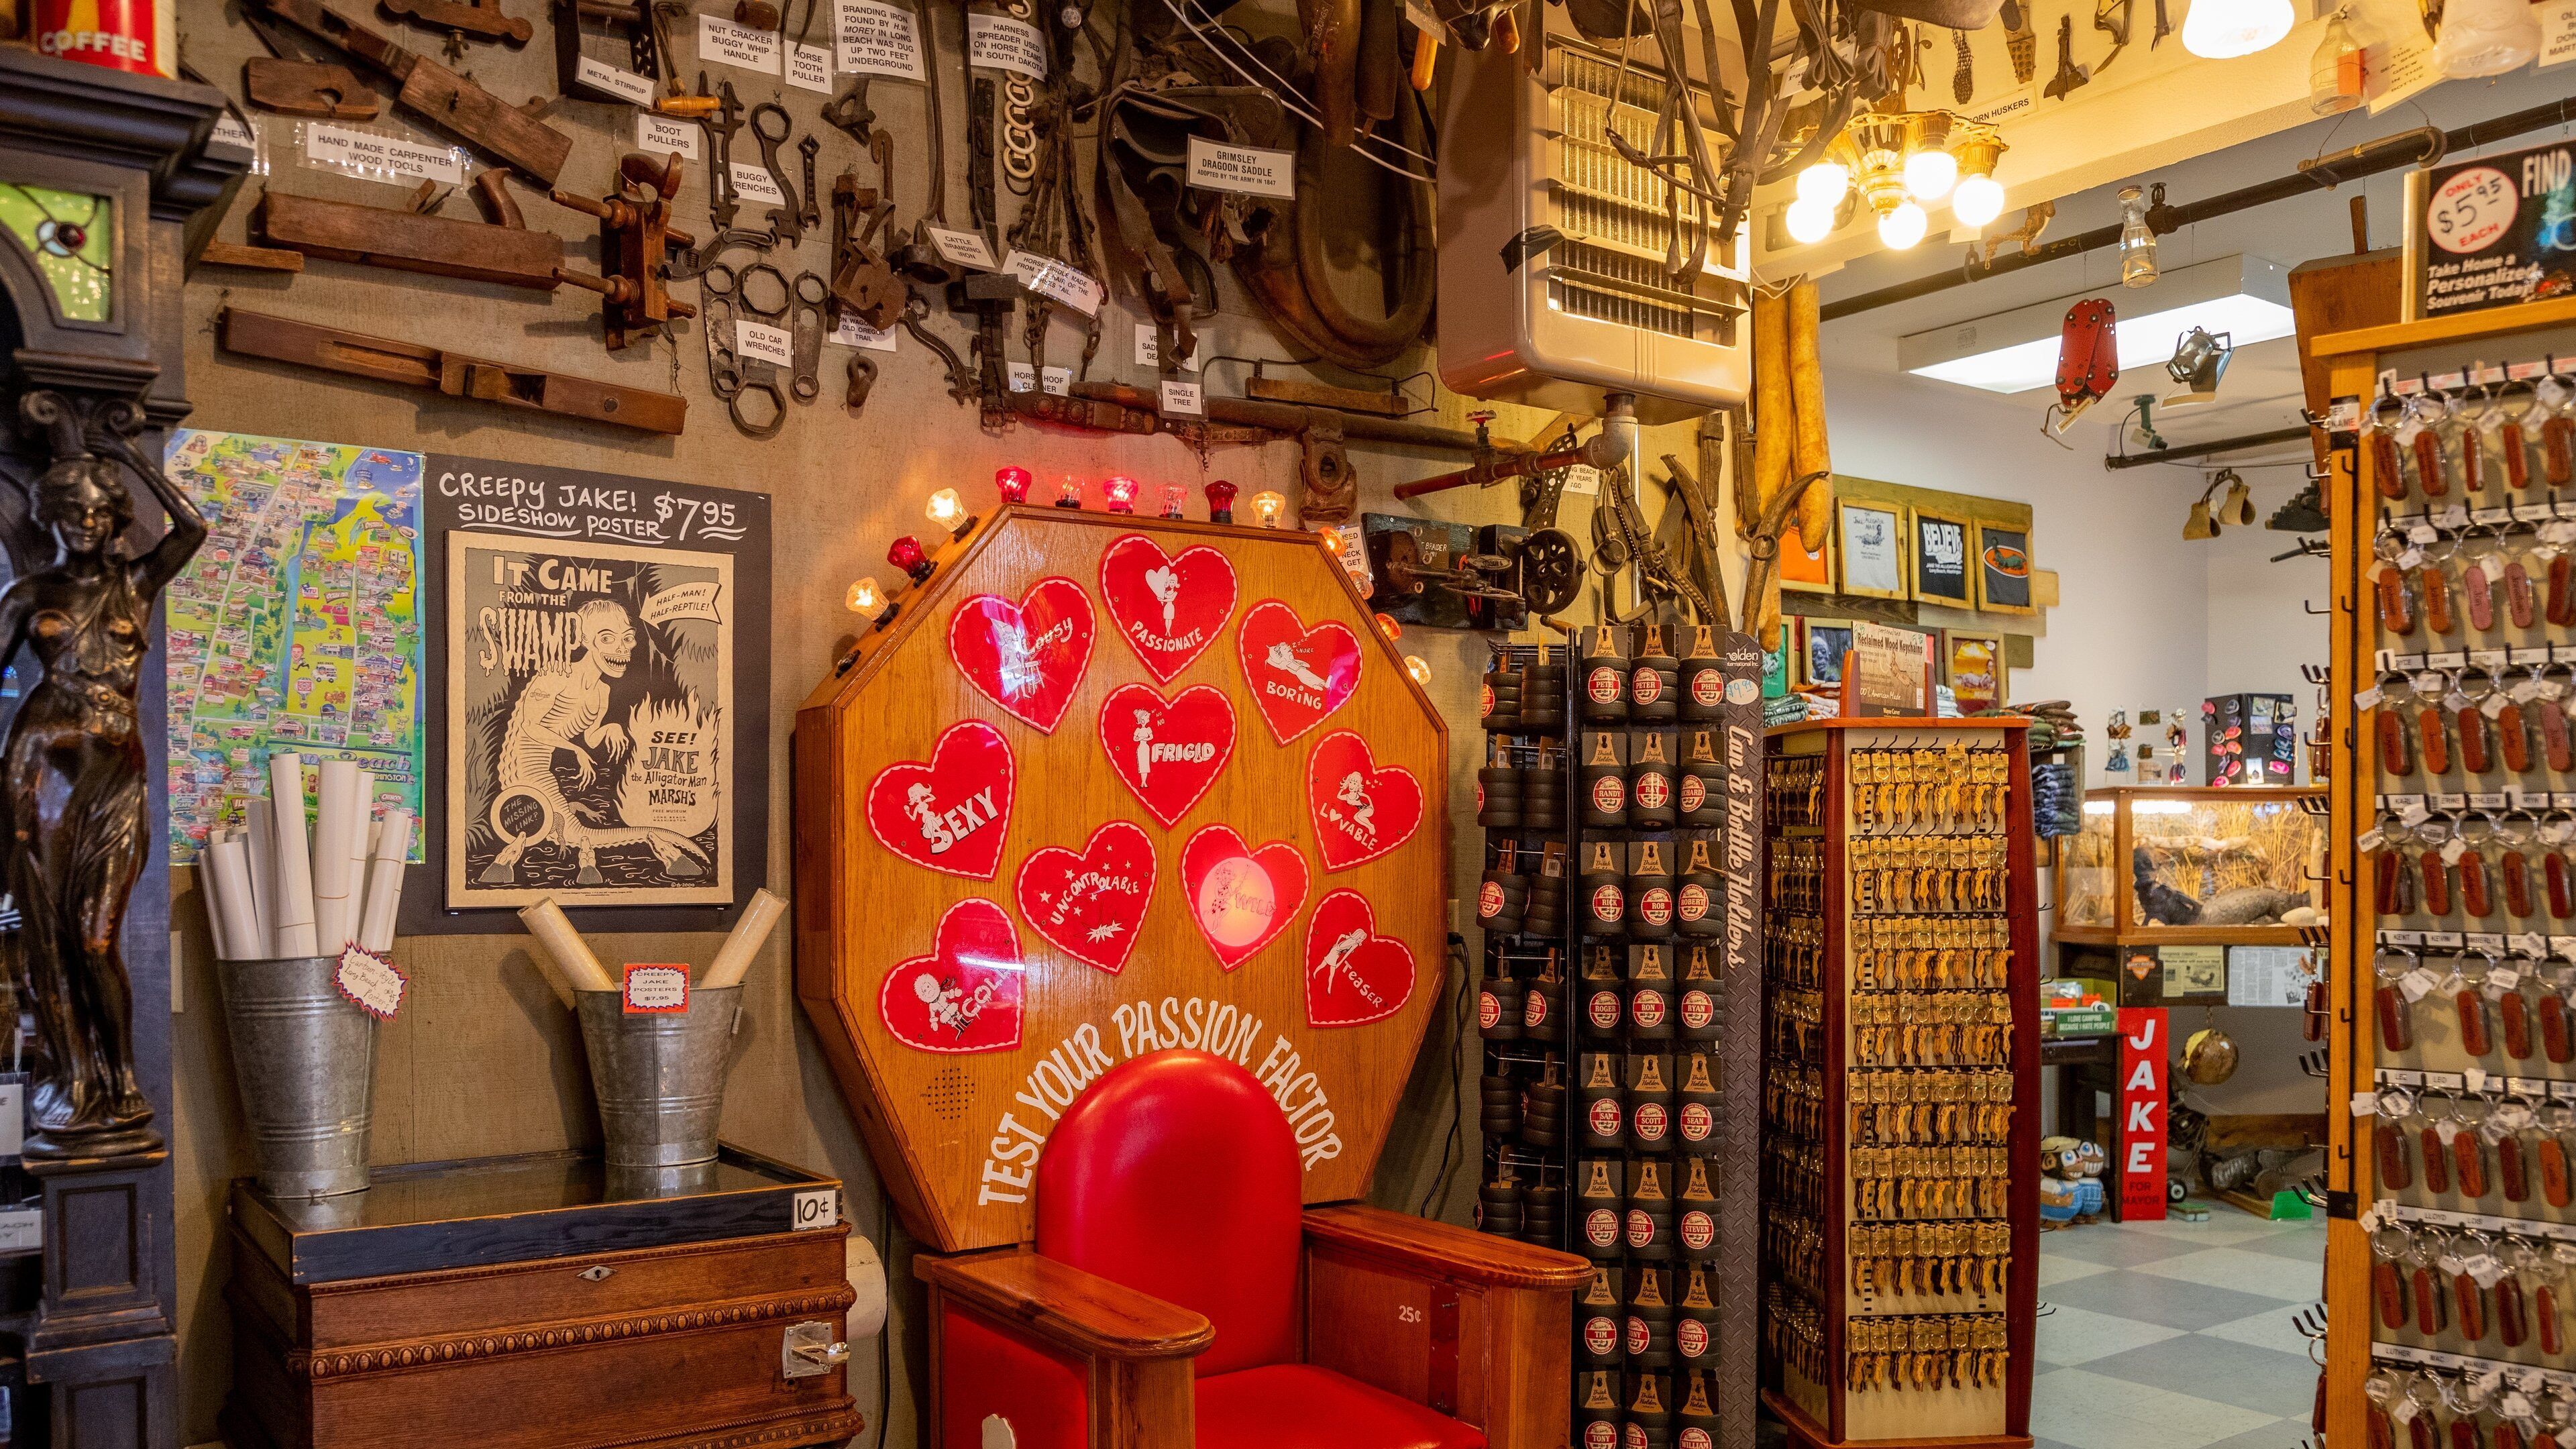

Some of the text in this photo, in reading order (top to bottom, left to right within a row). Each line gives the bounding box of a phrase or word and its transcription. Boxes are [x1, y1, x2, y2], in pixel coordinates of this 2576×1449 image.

[843, 5, 908, 23] BRANDING IRON
[845, 15, 875, 26] FOUND
[708, 24, 772, 45] NUT CRACKER
[844, 26, 911, 42] MOREY LONG
[994, 23, 1029, 38] HARNESS
[40, 29, 146, 62] COFFEE
[712, 36, 769, 55] BUGGY WHIP
[843, 36, 914, 52] BEACH WAS DUG
[977, 32, 1040, 52] SPREADER USED
[724, 49, 759, 62] HANDLE
[794, 50, 822, 63] HORSE
[867, 48, 885, 57] TWO
[890, 52, 910, 60] FEET
[991, 43, 1018, 53] HORSE
[1022, 48, 1042, 62] TEAMS
[2400, 48, 2426, 63] SHELL
[794, 60, 822, 72] TOOTH
[848, 56, 913, 71] UNDERGROUND
[986, 52, 1014, 62] SOUTH
[1018, 58, 1043, 73] DAKOTA
[2393, 61, 2417, 74] GREW
[587, 68, 646, 95] METAL STIRRUP
[792, 70, 825, 84] PULLER
[2391, 74, 2424, 92] BOTTLE
[1992, 99, 2029, 117] HUSKERS
[655, 124, 682, 136] BOOT
[647, 134, 689, 148] PULLERS
[318, 135, 452, 167] HAND MADE CARPENTER
[1217, 151, 1257, 164] GRIMSLEY
[349, 152, 423, 173] WOOD TOOLS
[1202, 158, 1272, 177] DRAGOON SADDLE
[737, 172, 767, 182] BUGGY
[1197, 169, 1219, 178] ADOPTED
[2522, 150, 2572, 198] FIND
[2445, 175, 2482, 197] ONLY
[945, 236, 972, 246] CATTLE
[2459, 223, 2500, 247] EACH
[944, 243, 981, 254] BRANDING
[958, 251, 976, 260] IRON
[1024, 258, 1069, 278] HORSE BRIDLE
[2428, 256, 2504, 278] Take Home
[1017, 262, 1089, 296] FROM THE
[2427, 262, 2541, 295] Personalized
[2427, 291, 2486, 309] Souvenir
[749, 331, 782, 345] OLD CAR
[859, 327, 885, 335] OREGON
[745, 340, 786, 357] WRENCHES
[1044, 376, 1063, 384] HOOF
[1169, 389, 1194, 397] SINGLE
[559, 485, 637, 513] JAKE!
[459, 503, 661, 537] SIDESHOW POSTER
[493, 555, 612, 594] IT CAME
[499, 590, 566, 607] FROM THE
[656, 588, 706, 606] HALF-MAN!
[649, 603, 710, 621] HALF-REPTILE!
[478, 607, 584, 678] SWAMP
[1130, 621, 1203, 652] PASSIONATE
[1858, 633, 1884, 647] Reclaimed
[1900, 640, 1923, 657] Keychains
[651, 731, 697, 745] SEE!
[1151, 743, 1216, 763] FRIGID
[1728, 725, 1753, 771] Can
[642, 747, 700, 774] JAKE
[645, 771, 707, 788] Alligator Man
[504, 798, 523, 812] THE
[649, 788, 697, 806] MARSH'S
[504, 802, 538, 827] MISSING
[515, 812, 539, 833] LINK?
[921, 786, 1000, 855] SEXY
[1727, 796, 1753, 869] Bottle
[1050, 871, 1139, 926] UNCONTROLABLE
[1234, 892, 1277, 917] WILD
[1727, 871, 1752, 968] Holders
[360, 972, 377, 990] Beach
[363, 987, 389, 1009] Posters
[978, 996, 1343, 1206] TEST YOUR PASSION FACTOR
[2126, 1018, 2158, 1173] JAKE
[2123, 1195, 2159, 1205] MAYOR
[797, 1197, 829, 1225] 10¢
[1589, 1222, 1617, 1230] STEPHEN
[1399, 1305, 1421, 1323] 25¢
[1681, 1333, 1703, 1341] TOMMY
[2385, 1348, 2411, 1357] LUTHER
